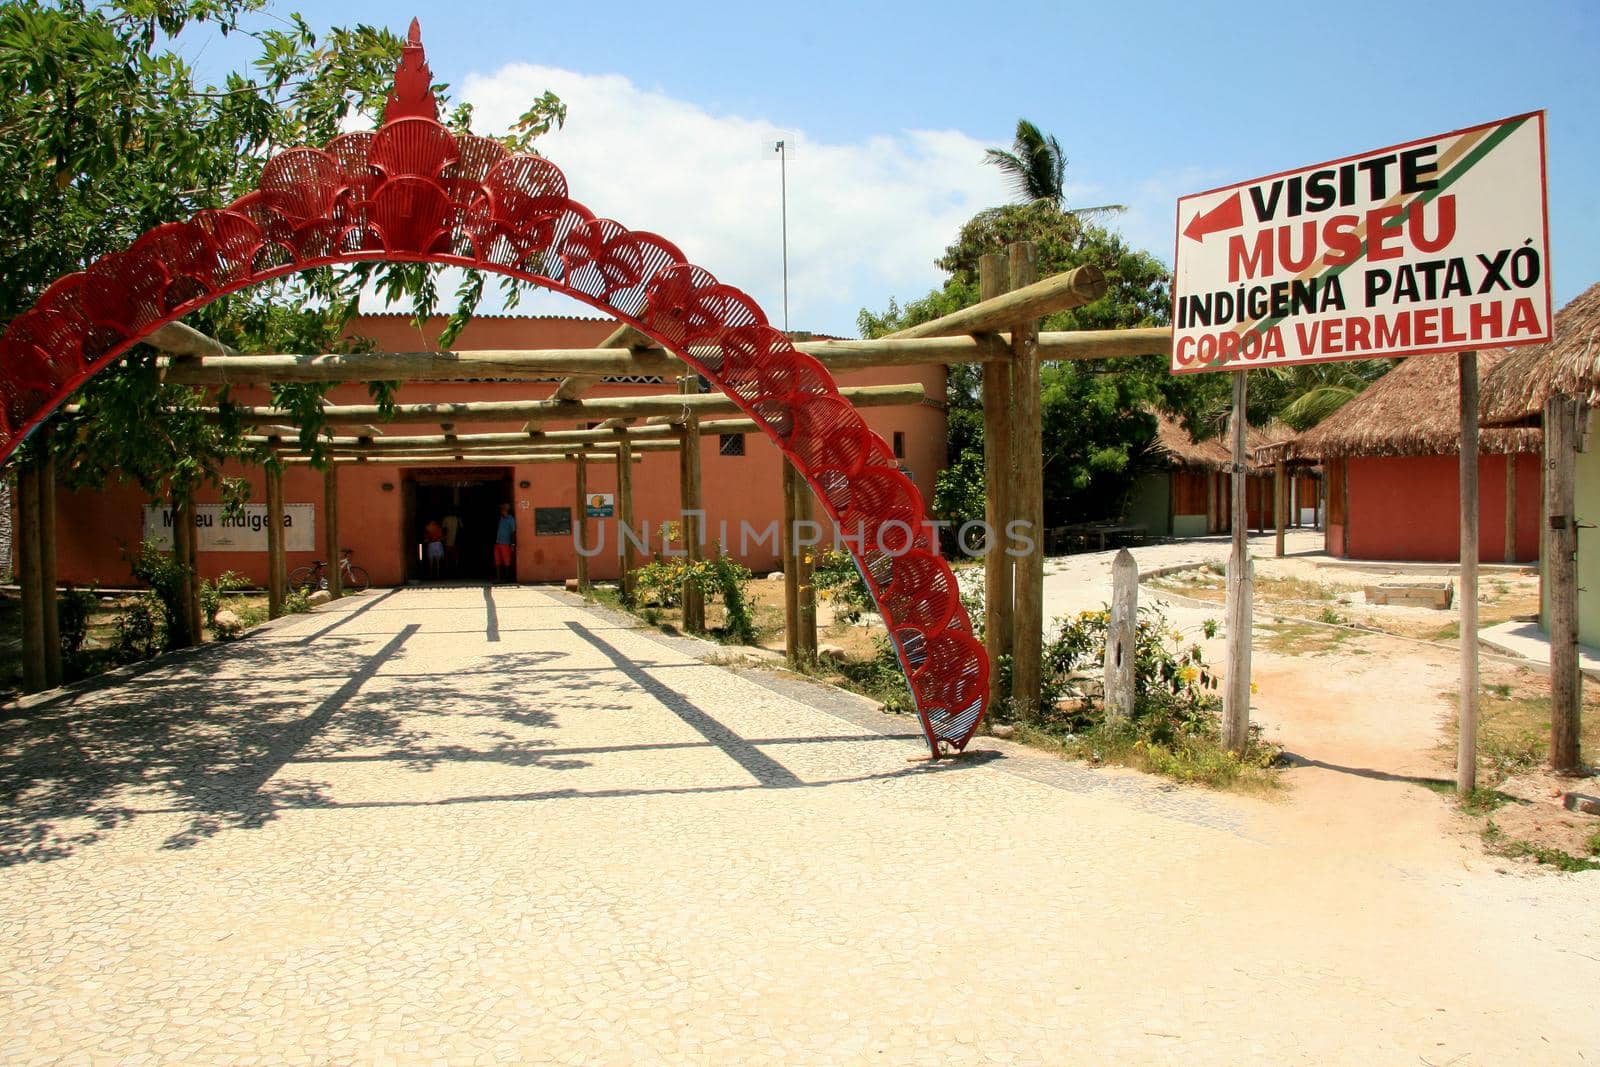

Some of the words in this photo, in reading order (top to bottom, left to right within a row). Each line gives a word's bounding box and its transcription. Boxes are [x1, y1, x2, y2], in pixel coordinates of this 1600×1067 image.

[1248, 144, 1438, 222] VISITE
[1228, 194, 1456, 283] MUSEU
[1177, 274, 1345, 329] INDÍGENA
[1364, 237, 1540, 308] PATAXÓ
[1176, 325, 1285, 366] COROA
[1295, 297, 1542, 356] VERMELHA
[163, 510, 213, 528] Meu
